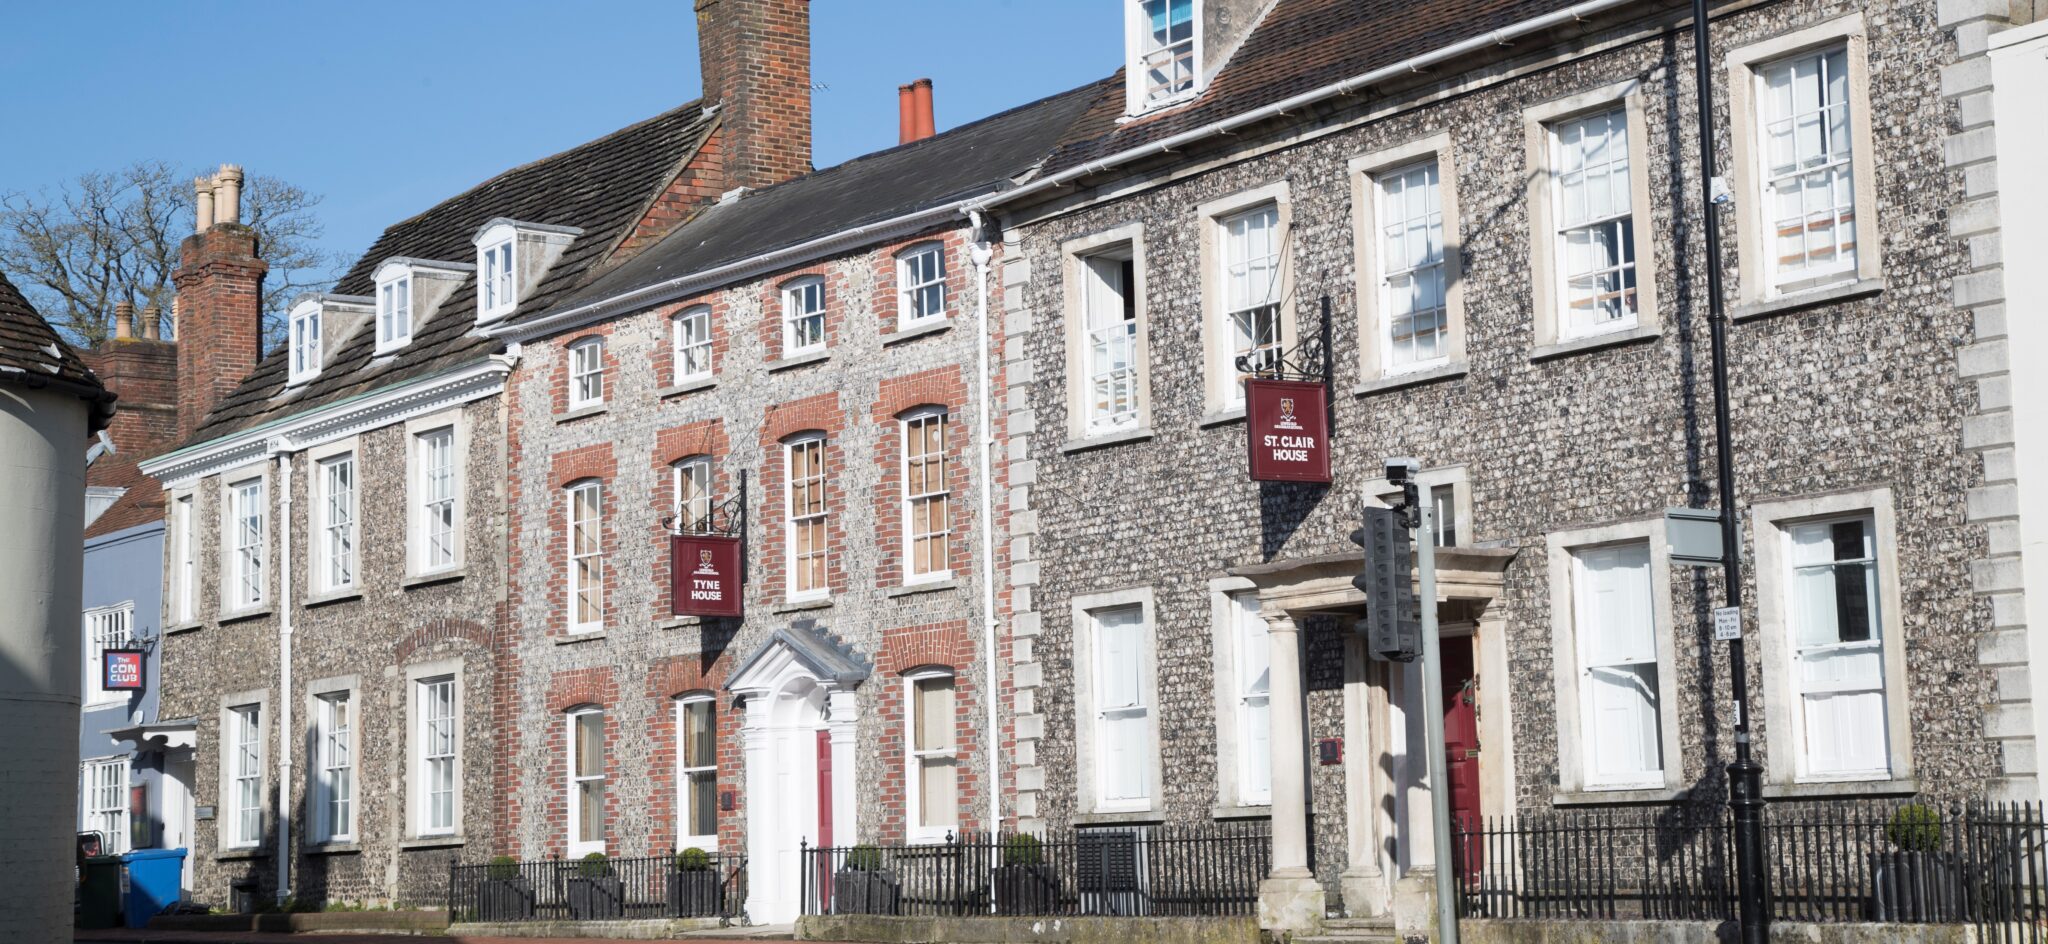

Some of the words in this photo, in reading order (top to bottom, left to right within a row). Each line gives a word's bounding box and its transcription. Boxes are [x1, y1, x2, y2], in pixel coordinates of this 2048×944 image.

[1264, 435, 1279, 447] ST.
[1281, 436, 1315, 448] CLAIR
[1273, 449, 1308, 462] HOUSE
[693, 580, 720, 590] TYNE
[691, 590, 722, 601] HOUSE
[110, 664, 136, 674] CON
[110, 674, 137, 682] CLUB
